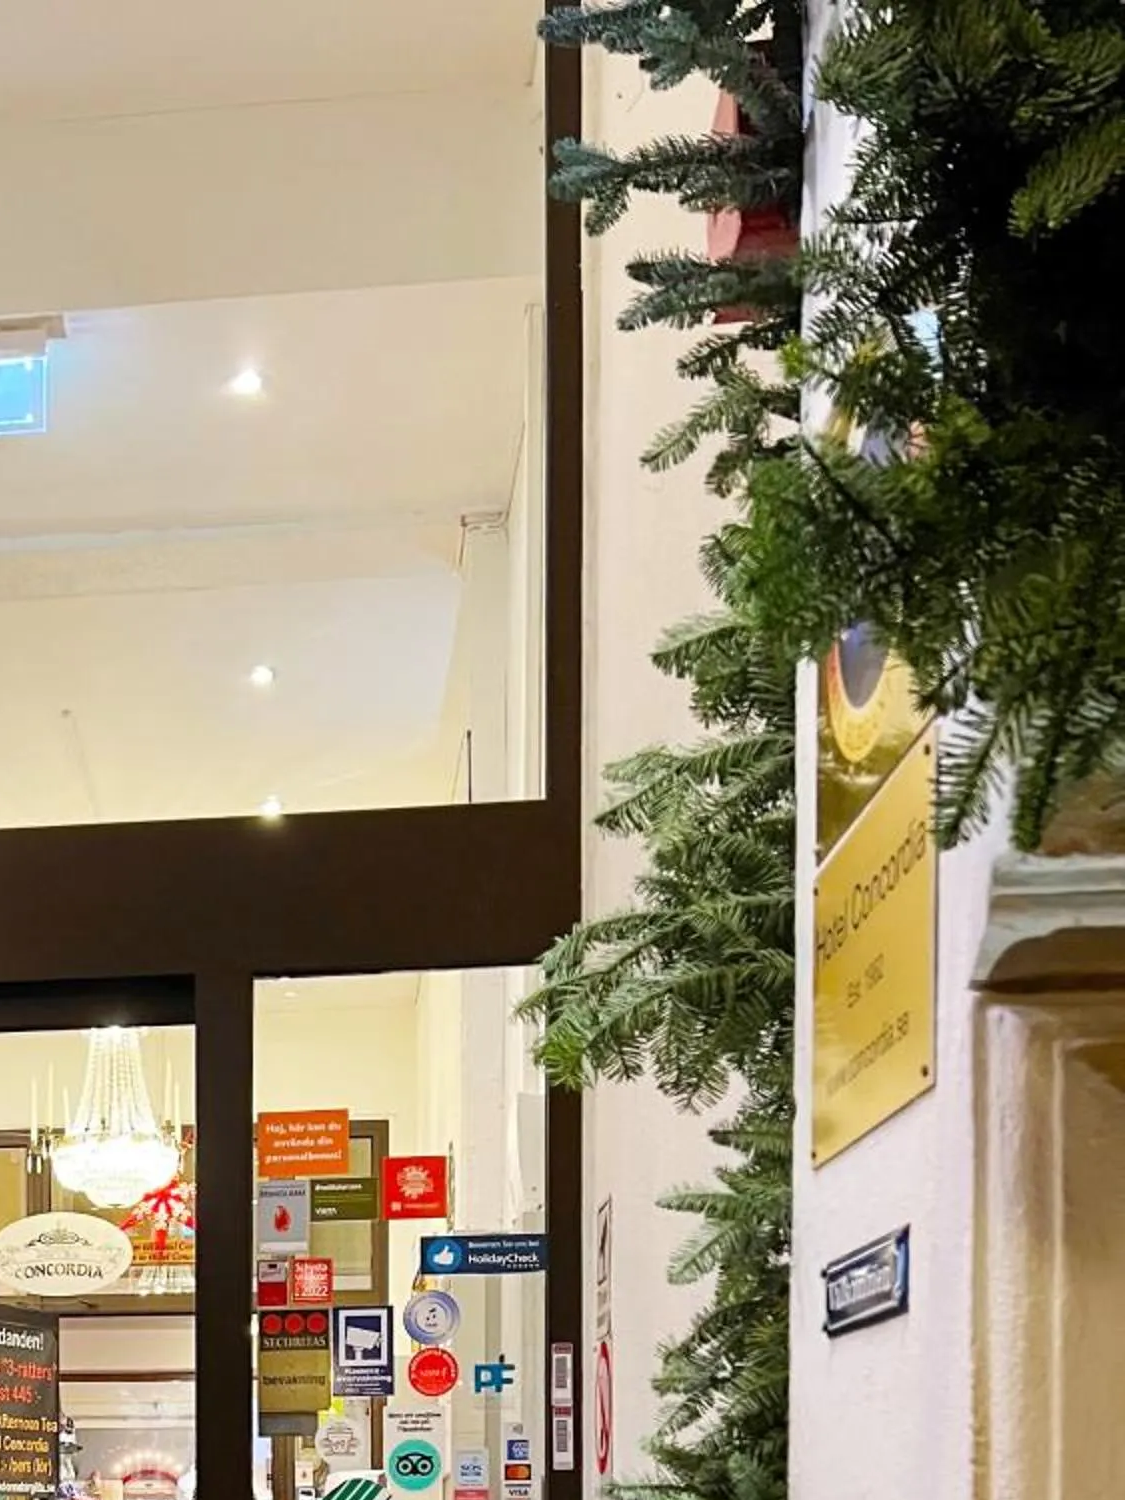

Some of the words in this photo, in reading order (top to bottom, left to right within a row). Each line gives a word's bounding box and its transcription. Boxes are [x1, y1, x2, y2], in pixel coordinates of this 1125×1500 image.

[852, 818, 926, 930] Concordia
[468, 1252, 540, 1267] HolidayCheck
[15, 1262, 103, 1279] CONCORDIA
[262, 1335, 326, 1348] SECURITAS
[41, 1417, 58, 1433] Tea
[3, 1435, 50, 1453] Concordia
